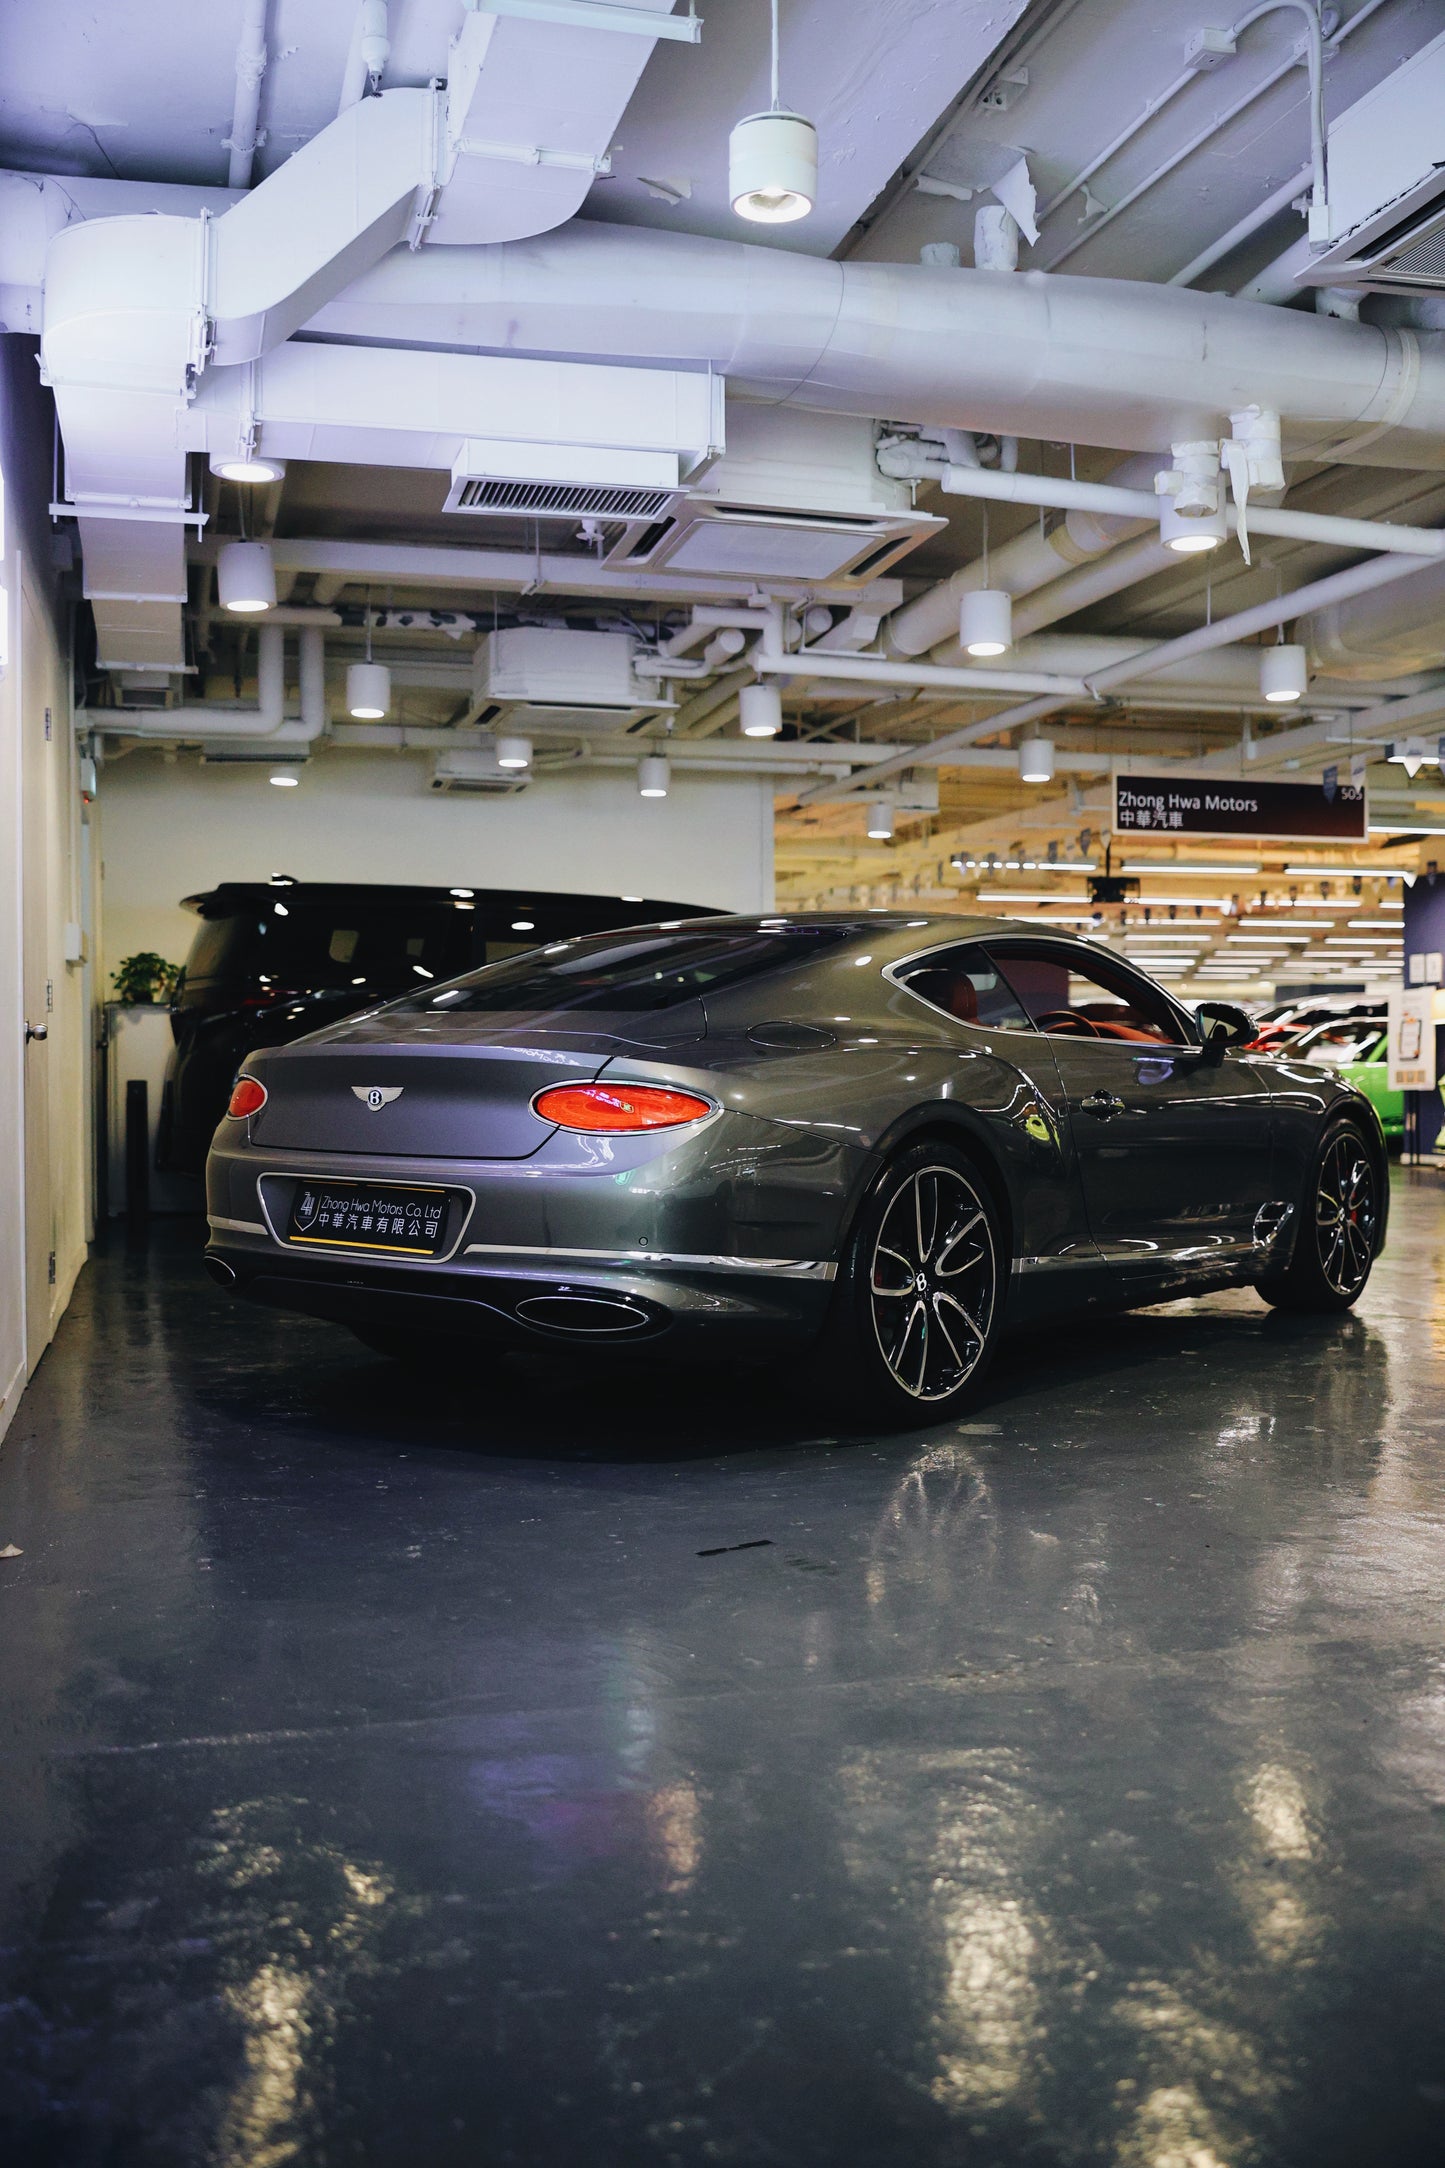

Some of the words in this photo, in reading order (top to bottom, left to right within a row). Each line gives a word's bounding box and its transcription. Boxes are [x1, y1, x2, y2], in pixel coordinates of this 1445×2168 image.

[1118, 791, 1165, 810] Zhong
[1168, 794, 1201, 810] Hwa
[1204, 795, 1258, 813] Motors
[1119, 809, 1184, 829] 中華汽車
[321, 1195, 349, 1213] Zhong
[351, 1199, 370, 1213] Hwa
[371, 1199, 403, 1216] Motors
[405, 1202, 422, 1218] Co.
[424, 1206, 442, 1219] Ltd
[318, 1212, 438, 1238] 中華汽車有限公司
